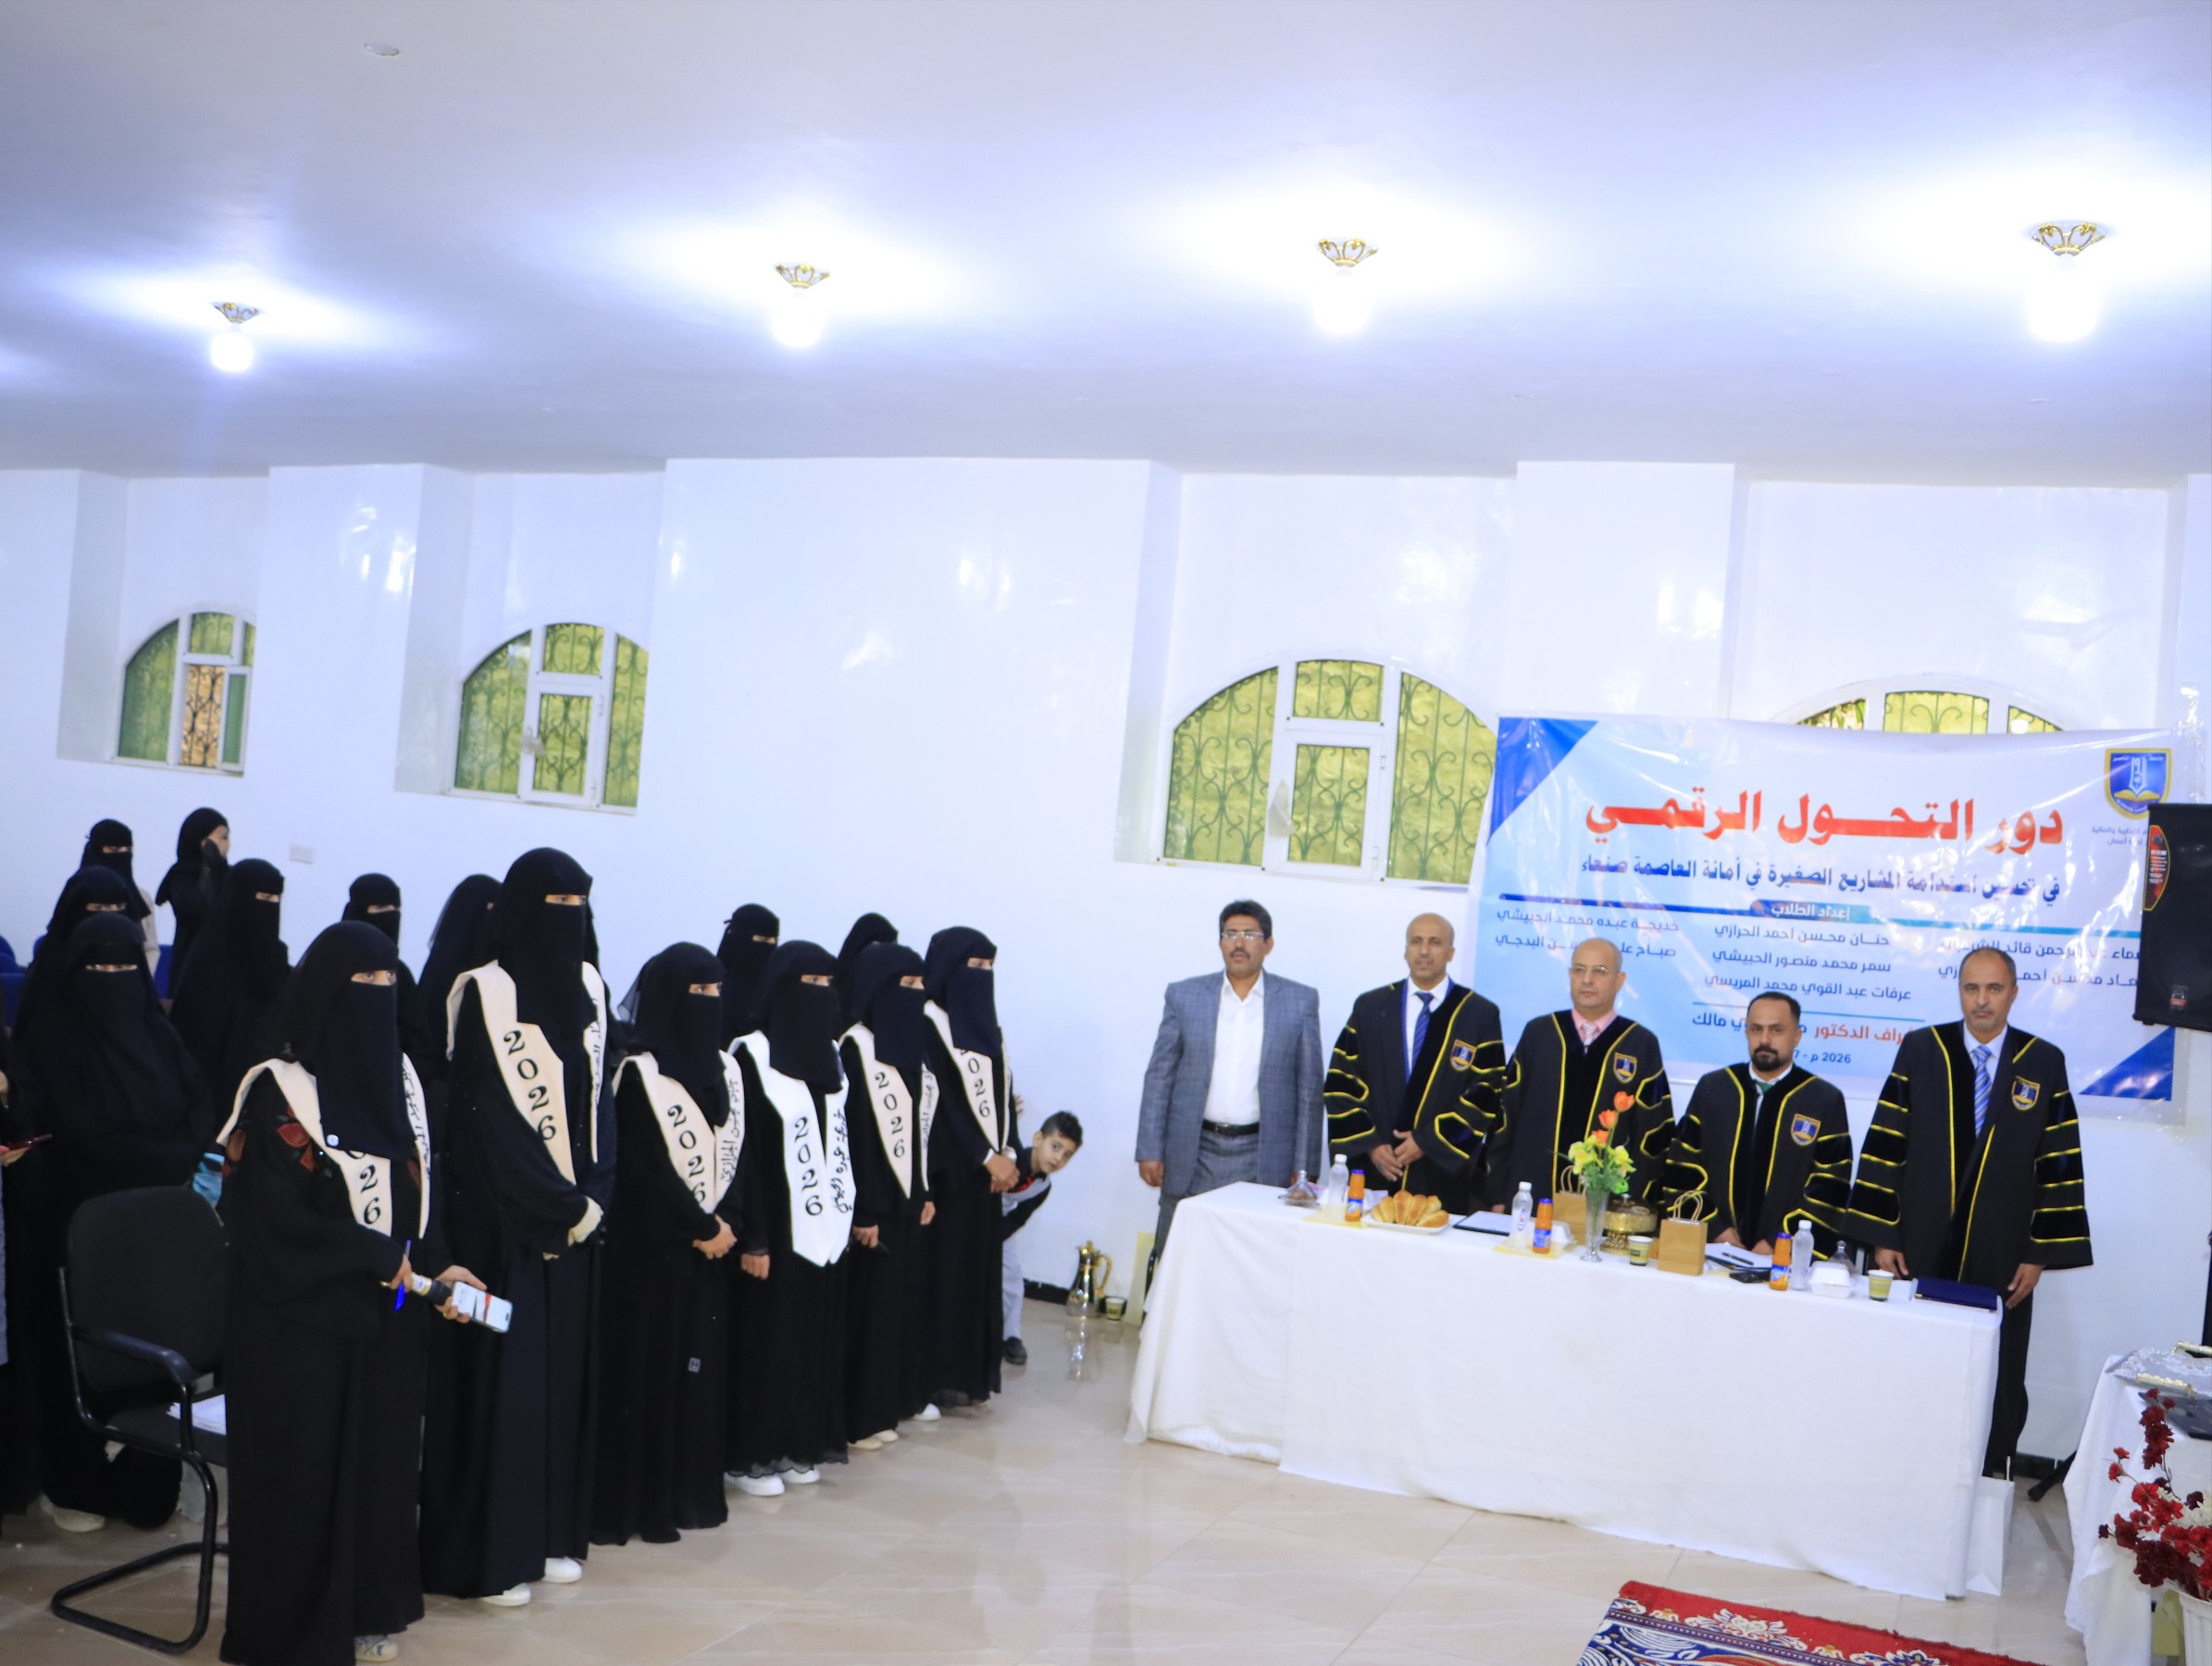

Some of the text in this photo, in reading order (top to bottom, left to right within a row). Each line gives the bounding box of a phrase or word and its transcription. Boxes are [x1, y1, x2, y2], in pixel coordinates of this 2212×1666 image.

[1585, 787, 2063, 855] دور التحول الرقمي
[1581, 853, 1629, 874] صنعاء
[1634, 855, 1696, 878] العاصمة
[1702, 856, 1740, 881] أمانة
[1746, 861, 1761, 890] في
[1767, 864, 1833, 888] الصغيرة
[1838, 867, 1900, 893] المشاريع
[1982, 876, 2036, 900] تحسين
[2043, 877, 2060, 906] في
[1497, 907, 1680, 932] خديجة عبده محمد الحبيشي
[1771, 902, 1850, 921] إعداد الطلاب
[1495, 931, 1545, 948] البدجي
[1714, 923, 1891, 946] حنان محسن أحمد الحرازي
[1620, 941, 1634, 954] عل
[1635, 942, 1677, 958] صباح
[1712, 948, 1891, 974] سمر محمد منصور الحبيشي
[2017, 967, 2046, 981] أحم
[1704, 973, 1912, 1001] عرفات عبد القوي محمد المريسي
[1692, 1012, 1727, 1027] مالك
[1814, 1023, 1870, 1039] الدكتور
[1821, 1051, 1851, 1064] 2026
[503, 1028, 557, 1141] 2026
[875, 1071, 905, 1159] 2026
[667, 1103, 706, 1204] 2026
[794, 1115, 824, 1217] 2026
